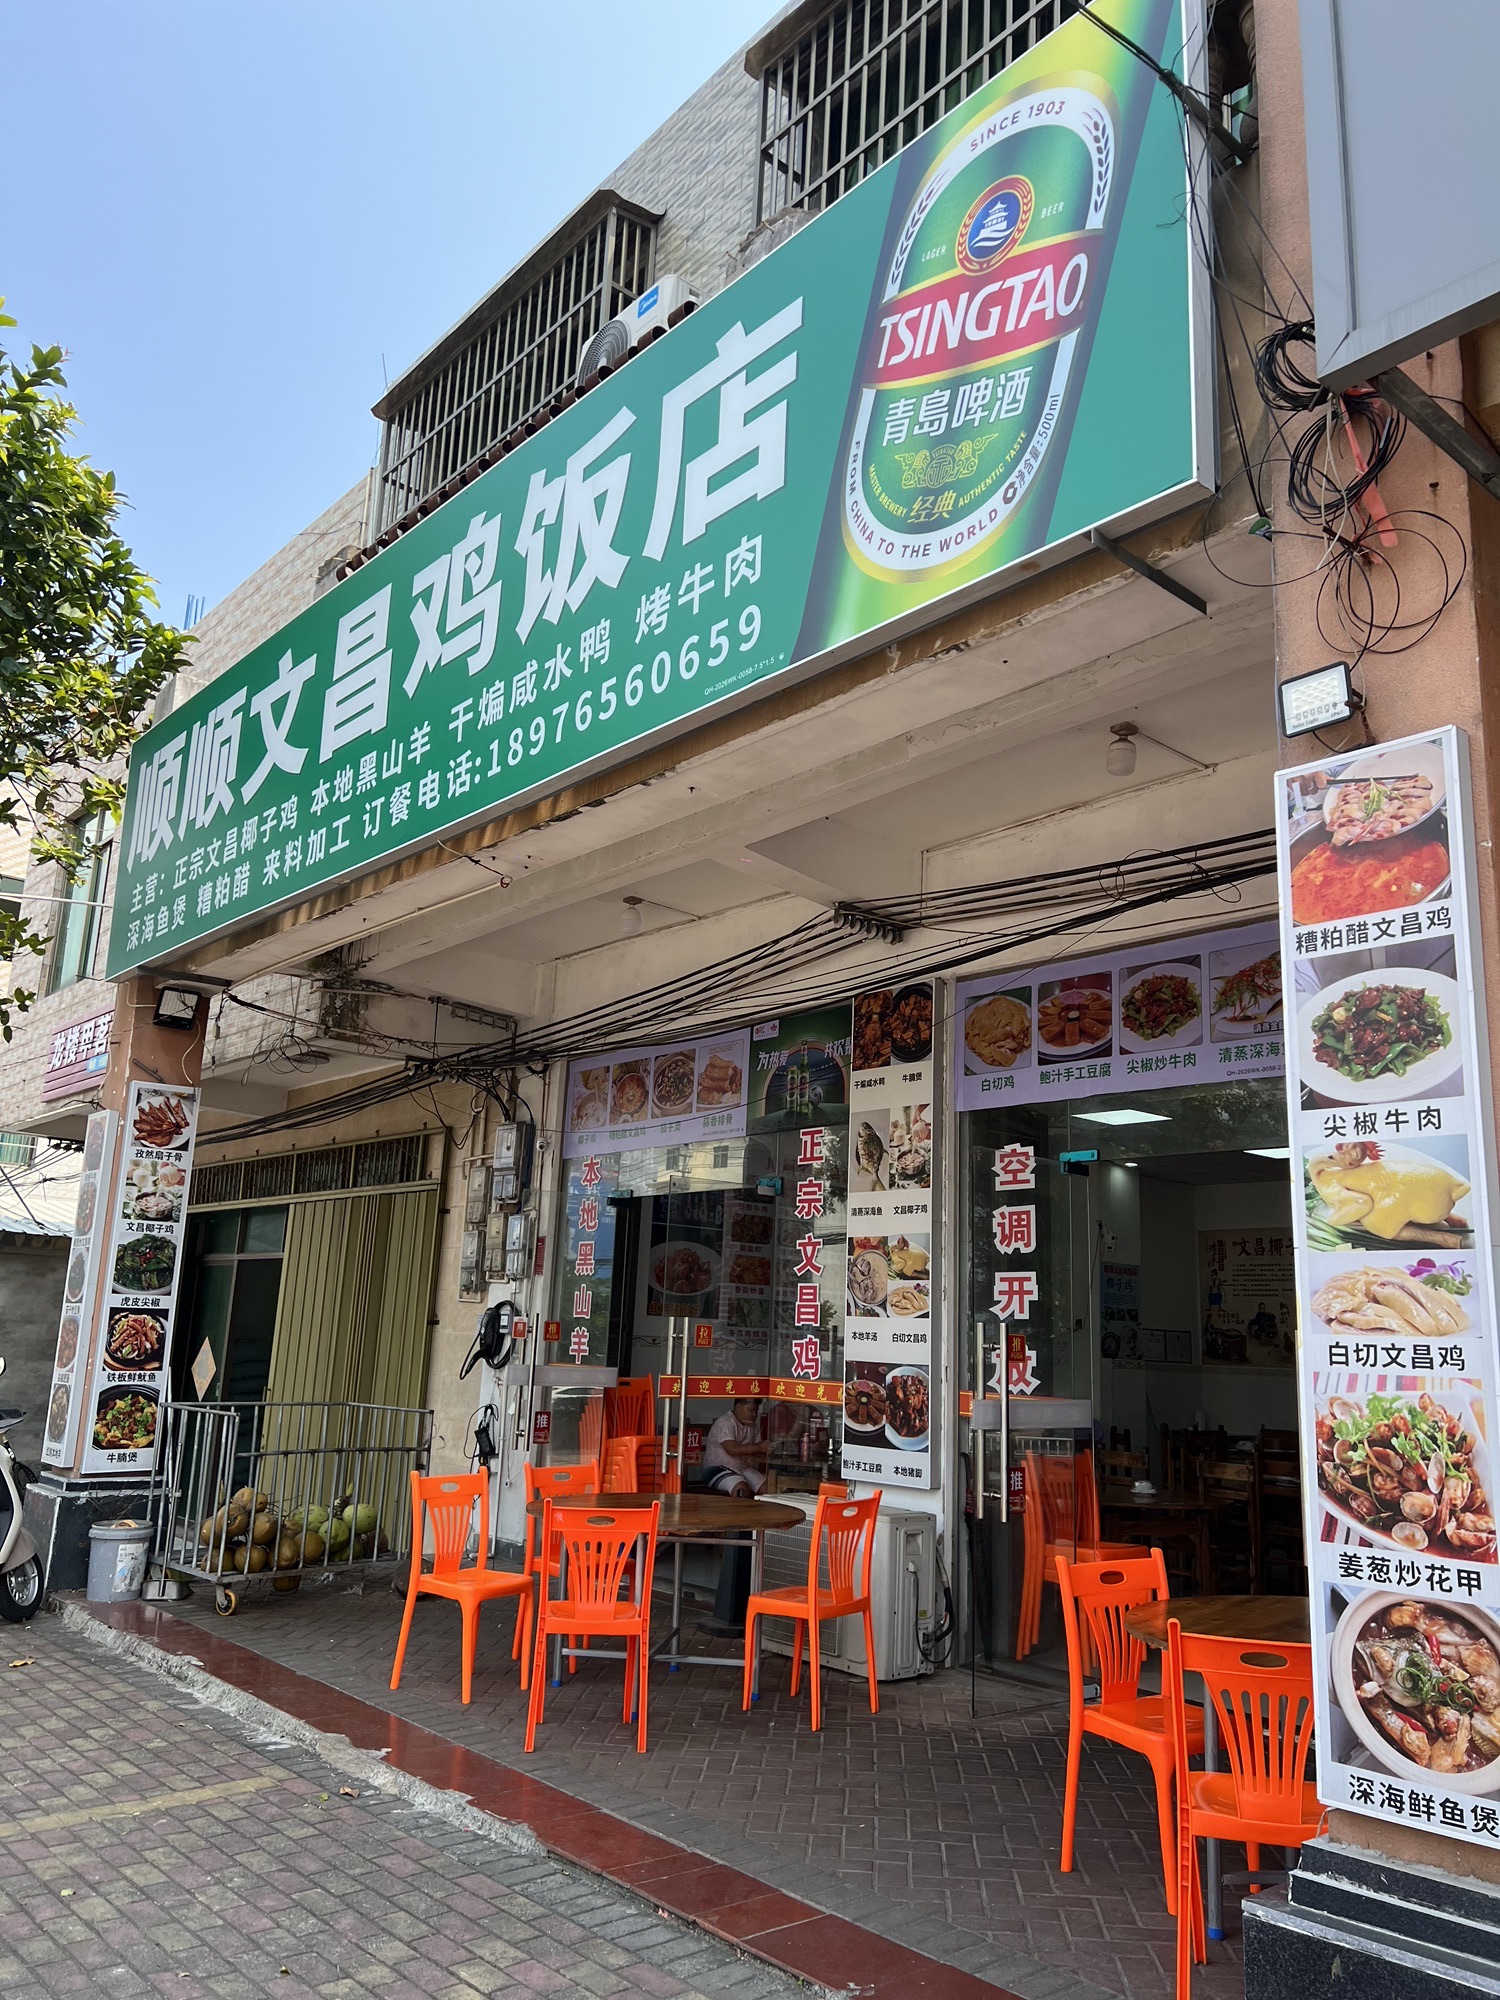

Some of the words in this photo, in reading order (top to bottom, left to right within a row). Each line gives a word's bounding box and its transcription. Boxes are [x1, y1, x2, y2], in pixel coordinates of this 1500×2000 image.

[971, 109, 1021, 152] SINCE
[1028, 100, 1066, 119] 1903
[1040, 201, 1065, 219] BEER
[921, 245, 947, 262] LAGER
[877, 252, 1089, 369] TSINGTAO
[882, 365, 1034, 447] 青島啤酒
[848, 440, 861, 496] FROM
[958, 462, 1006, 508] AUTHENTIC
[1006, 430, 1028, 464] TASTE
[868, 463, 881, 497] MASTER
[878, 491, 908, 518] BREWERY
[907, 488, 958, 523] 经典
[850, 500, 875, 545] CHINA
[938, 508, 999, 553] WORLD
[877, 537, 895, 556] TO
[901, 543, 932, 559] THE
[126, 296, 804, 875] 顺顺文昌鸡饭店
[310, 720, 432, 817] 本地黑山羊
[448, 618, 612, 743] 干煸咸水鸭
[634, 533, 763, 645] 烤牛肉
[126, 897, 187, 952] 深海鱼煲
[196, 861, 252, 919] 糟粕醋
[262, 814, 351, 886] 来料加工
[1295, 905, 1453, 955] 糟粕醋文昌鸡
[980, 1075, 1015, 1093] 白切鸡
[1039, 1062, 1112, 1085] 鲍汁手工豆腐
[1126, 1052, 1197, 1075] 尖椒炒牛肉
[1323, 1105, 1442, 1139] 尖椒牛肉
[135, 1148, 184, 1162] 孜然扇子骨
[893, 1203, 928, 1215] 文昌椰子鸡
[125, 1221, 175, 1235] 文昌椰子鸡
[569, 1156, 600, 1364] 本地黑山羊
[792, 1128, 824, 1379] 正宗文昌鸡
[120, 1296, 161, 1307] 虎皮尖椒
[548, 1322, 557, 1335] 推
[699, 1326, 710, 1339] 拉
[851, 1331, 878, 1342] 本地羊汤
[892, 1332, 928, 1344] 白切文昌鸡
[1011, 1336, 1022, 1352] 推
[1327, 1340, 1466, 1372] 白切文昌鸡
[106, 1371, 157, 1383] 铁板鲜鱿鱼
[536, 1413, 549, 1429] 推
[686, 1431, 701, 1448] 拉
[105, 1451, 138, 1464] 牛腩煲
[1010, 1470, 1024, 1491] 推
[1338, 1551, 1483, 1597] 姜葱炒花甲
[1348, 1773, 1500, 1839] 深海鲜鱼煲
